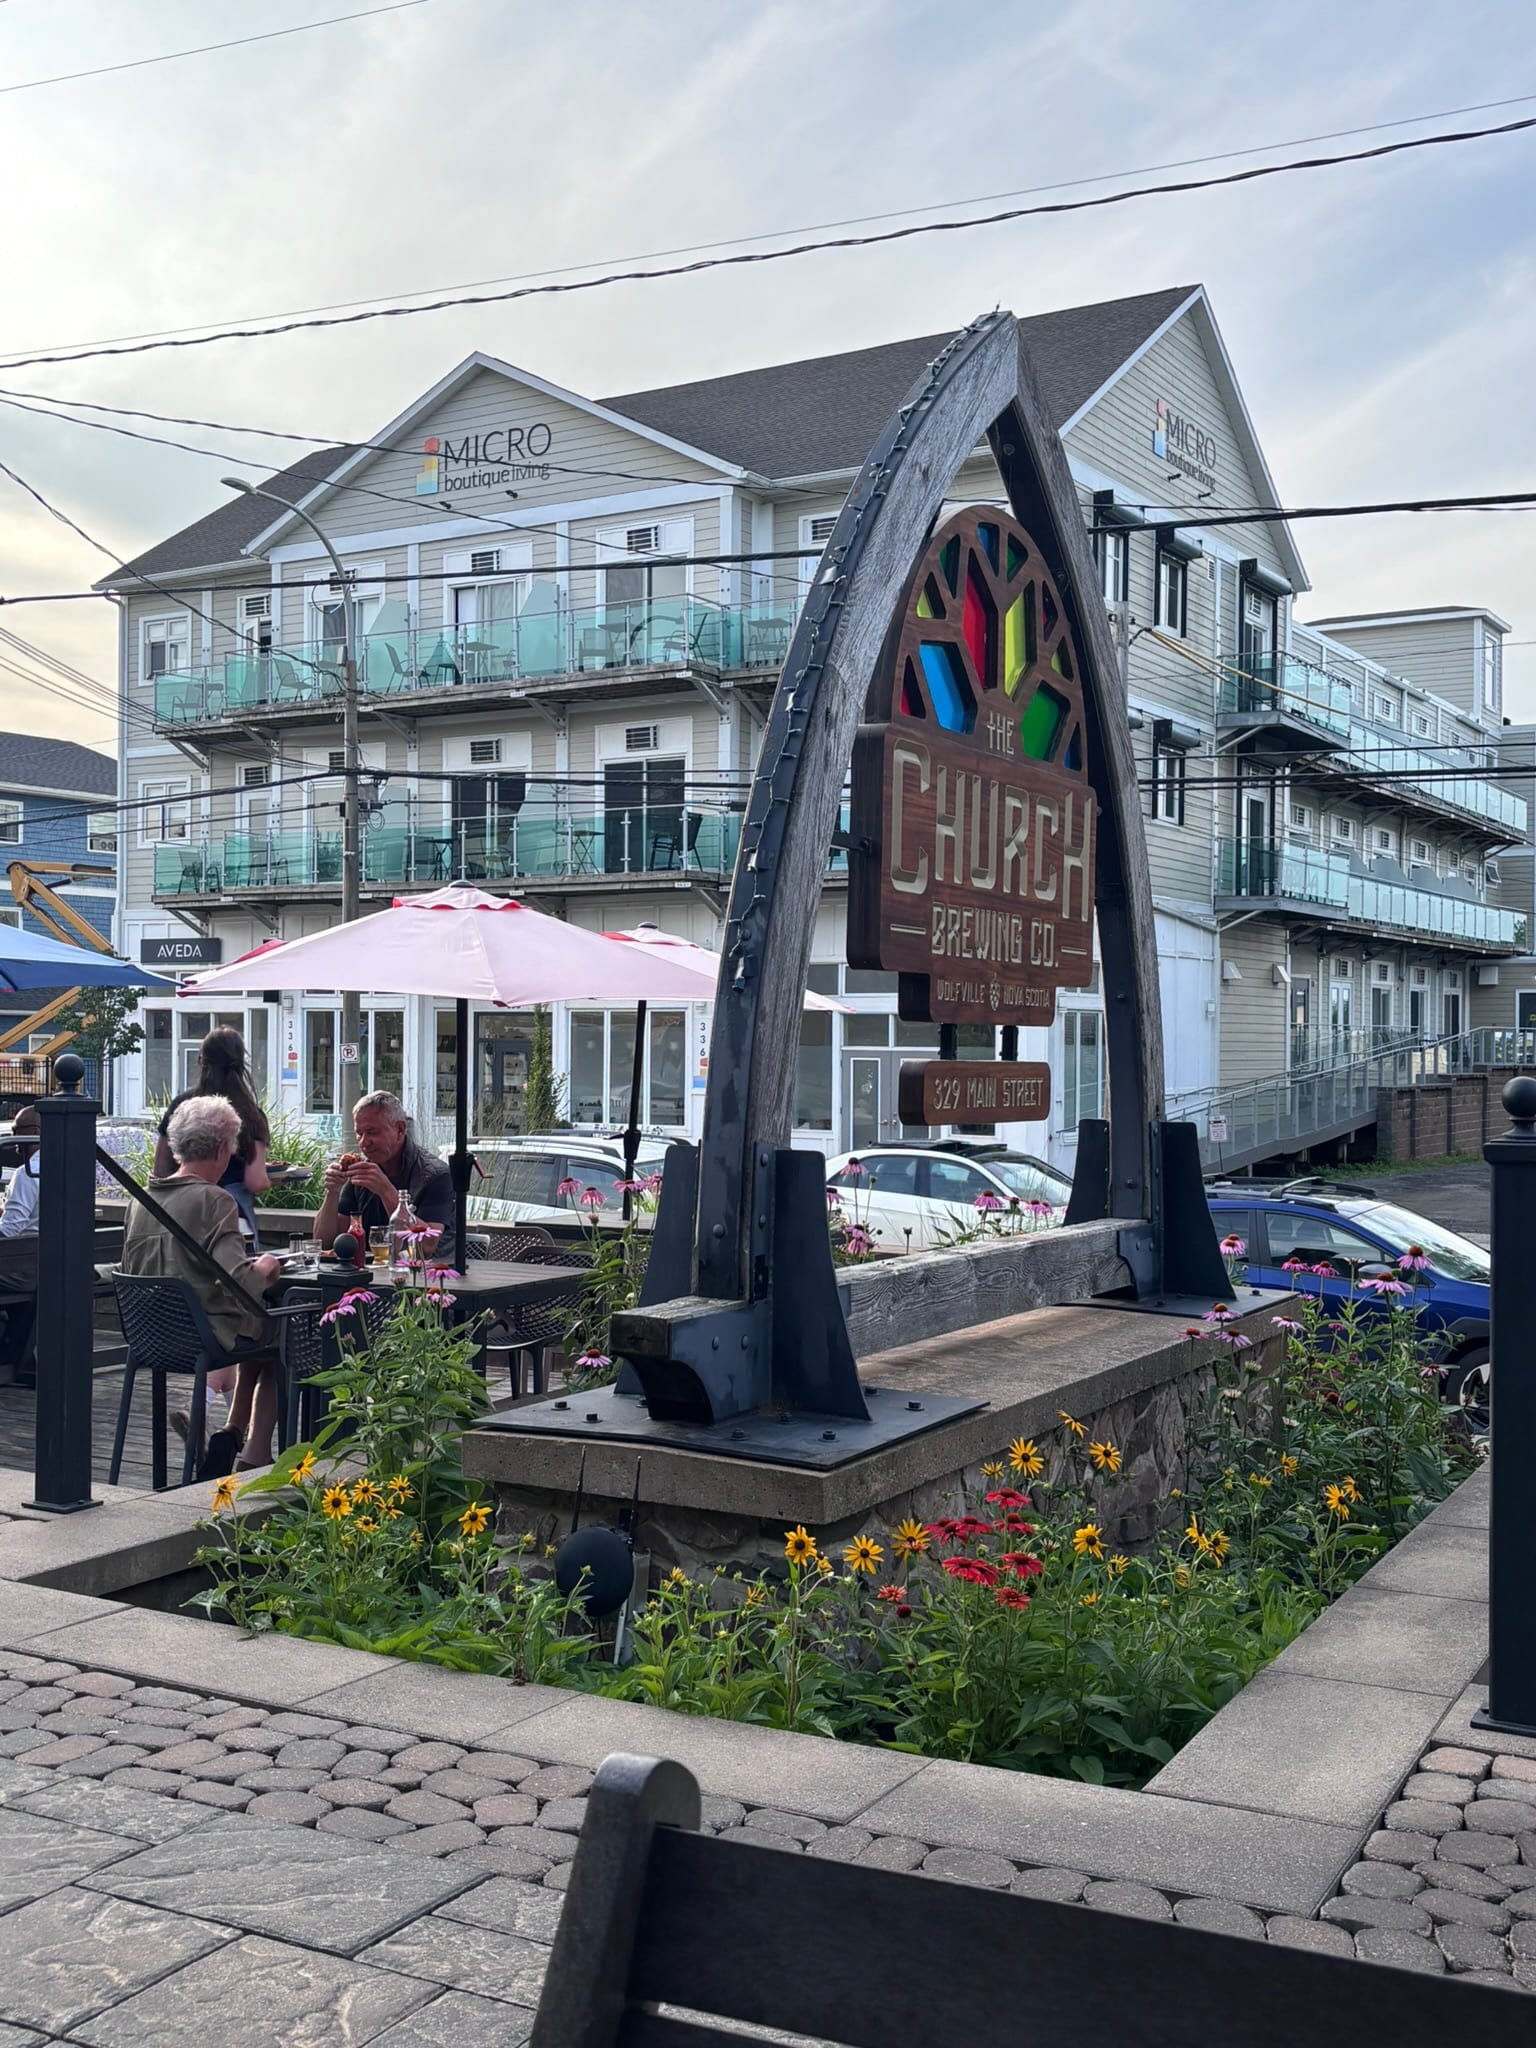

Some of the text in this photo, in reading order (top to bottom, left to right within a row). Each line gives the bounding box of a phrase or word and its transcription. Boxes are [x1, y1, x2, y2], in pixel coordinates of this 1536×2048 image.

[445, 423, 551, 471] MICRO
[1167, 408, 1216, 469] MICRO
[445, 461, 550, 492] boutique living
[987, 711, 1015, 755] THE
[890, 737, 1093, 922] CHURCH
[157, 944, 202, 958] AVEDA
[931, 902, 1059, 968] BREWING CO.
[937, 979, 985, 1003] WOLFVILLE
[1003, 986, 1050, 1008] NOVA SCOTIA
[933, 1076, 1044, 1110] 329 MAIN STREET
